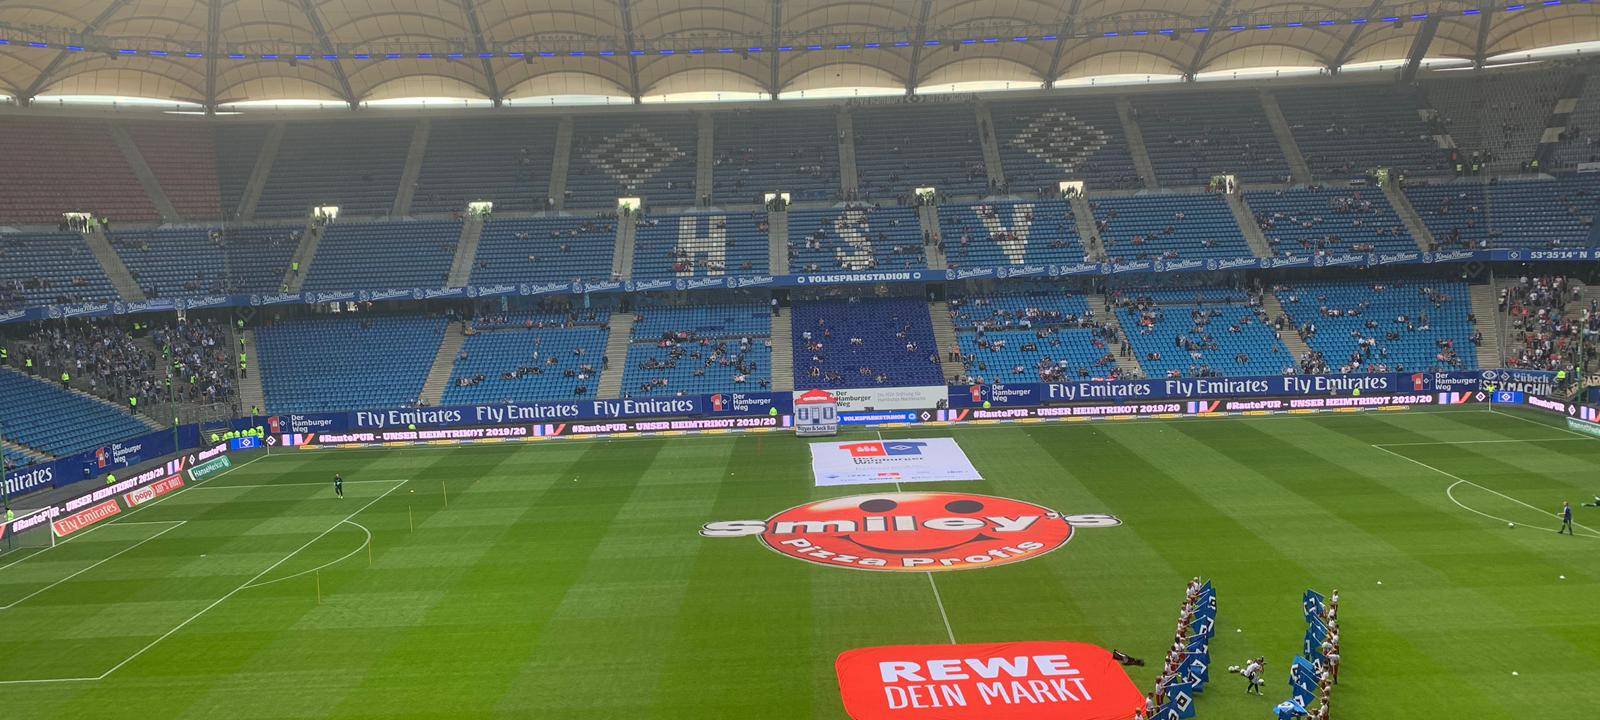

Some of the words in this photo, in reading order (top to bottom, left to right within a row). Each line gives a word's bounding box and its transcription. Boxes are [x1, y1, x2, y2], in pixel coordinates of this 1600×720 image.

[676, 216, 727, 276] H
[834, 209, 873, 270] S
[971, 204, 1035, 264] V
[808, 272, 910, 283] VOLKSPARKSTADION
[1166, 380, 1193, 397] Fly
[1197, 378, 1268, 394] Emirates
[1283, 377, 1311, 393] Fly
[1315, 376, 1388, 391] Emirates
[1435, 377, 1476, 385] Hamburger
[992, 388, 1031, 397] Hamburger
[1050, 383, 1076, 400] Fly
[1080, 382, 1150, 397] Emirates
[594, 400, 620, 417] Fly
[624, 398, 694, 414] Emirates
[733, 398, 771, 406] Hamburger
[733, 404, 748, 412] Weg
[1290, 398, 1325, 408] UNSER
[1326, 396, 1390, 406] HEIMTRIKOT
[1392, 395, 1432, 404] 2019/20
[476, 406, 504, 422] Fly
[507, 404, 578, 420] Emirates
[1038, 406, 1072, 416] UNSER
[1073, 404, 1138, 416] HEIMTRIKOT
[1140, 404, 1180, 412] 2019/20
[292, 418, 332, 428] Hamburger
[356, 411, 384, 428] Fly
[389, 409, 461, 425] Emirates
[636, 421, 670, 430] UNSER
[671, 418, 735, 430] HEIMTRIKOT
[737, 418, 776, 427] 2019/20
[292, 426, 308, 434] Weg
[382, 431, 418, 441] UNSER
[418, 428, 484, 440] HEIMTRIKOT
[486, 427, 526, 437] 2019/20
[112, 443, 122, 451] Der
[113, 444, 142, 457] Hamburger
[114, 455, 126, 464] Weg
[194, 461, 224, 478] HanseMerkur
[0, 467, 52, 496] mirates
[134, 490, 152, 502] popp
[60, 521, 78, 532] Fly
[76, 502, 117, 525] Emirates
[779, 538, 889, 567] Pizza
[902, 539, 1045, 568] Profis
[878, 654, 1081, 683] REWE
[884, 683, 968, 710] DEIN
[976, 677, 1093, 705] MARKT
